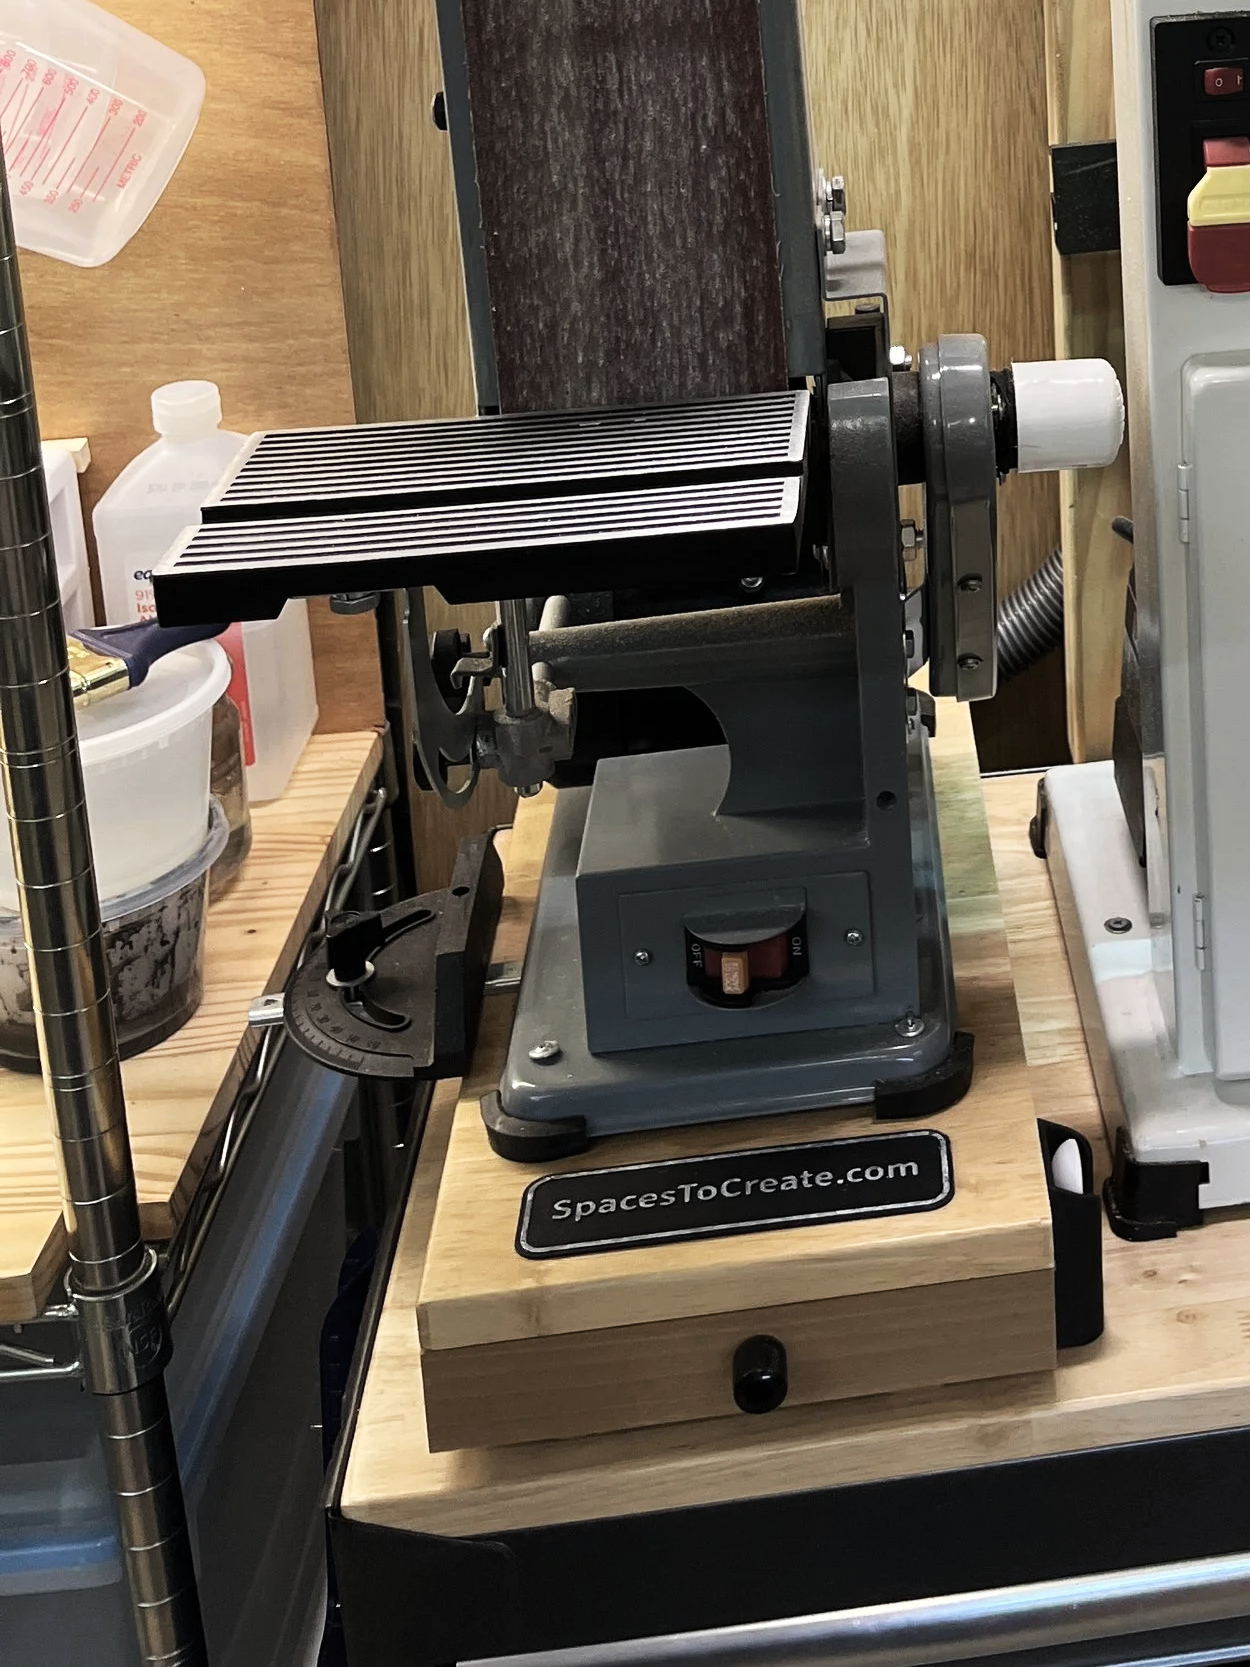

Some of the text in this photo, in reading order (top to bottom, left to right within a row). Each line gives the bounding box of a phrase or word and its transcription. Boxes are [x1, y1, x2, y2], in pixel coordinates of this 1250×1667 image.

[87, 88, 100, 105] 400
[117, 152, 142, 190] METRIC
[691, 943, 703, 968] OFF
[791, 936, 803, 956] ON
[551, 1158, 919, 1223] SpacesToCreate.com
